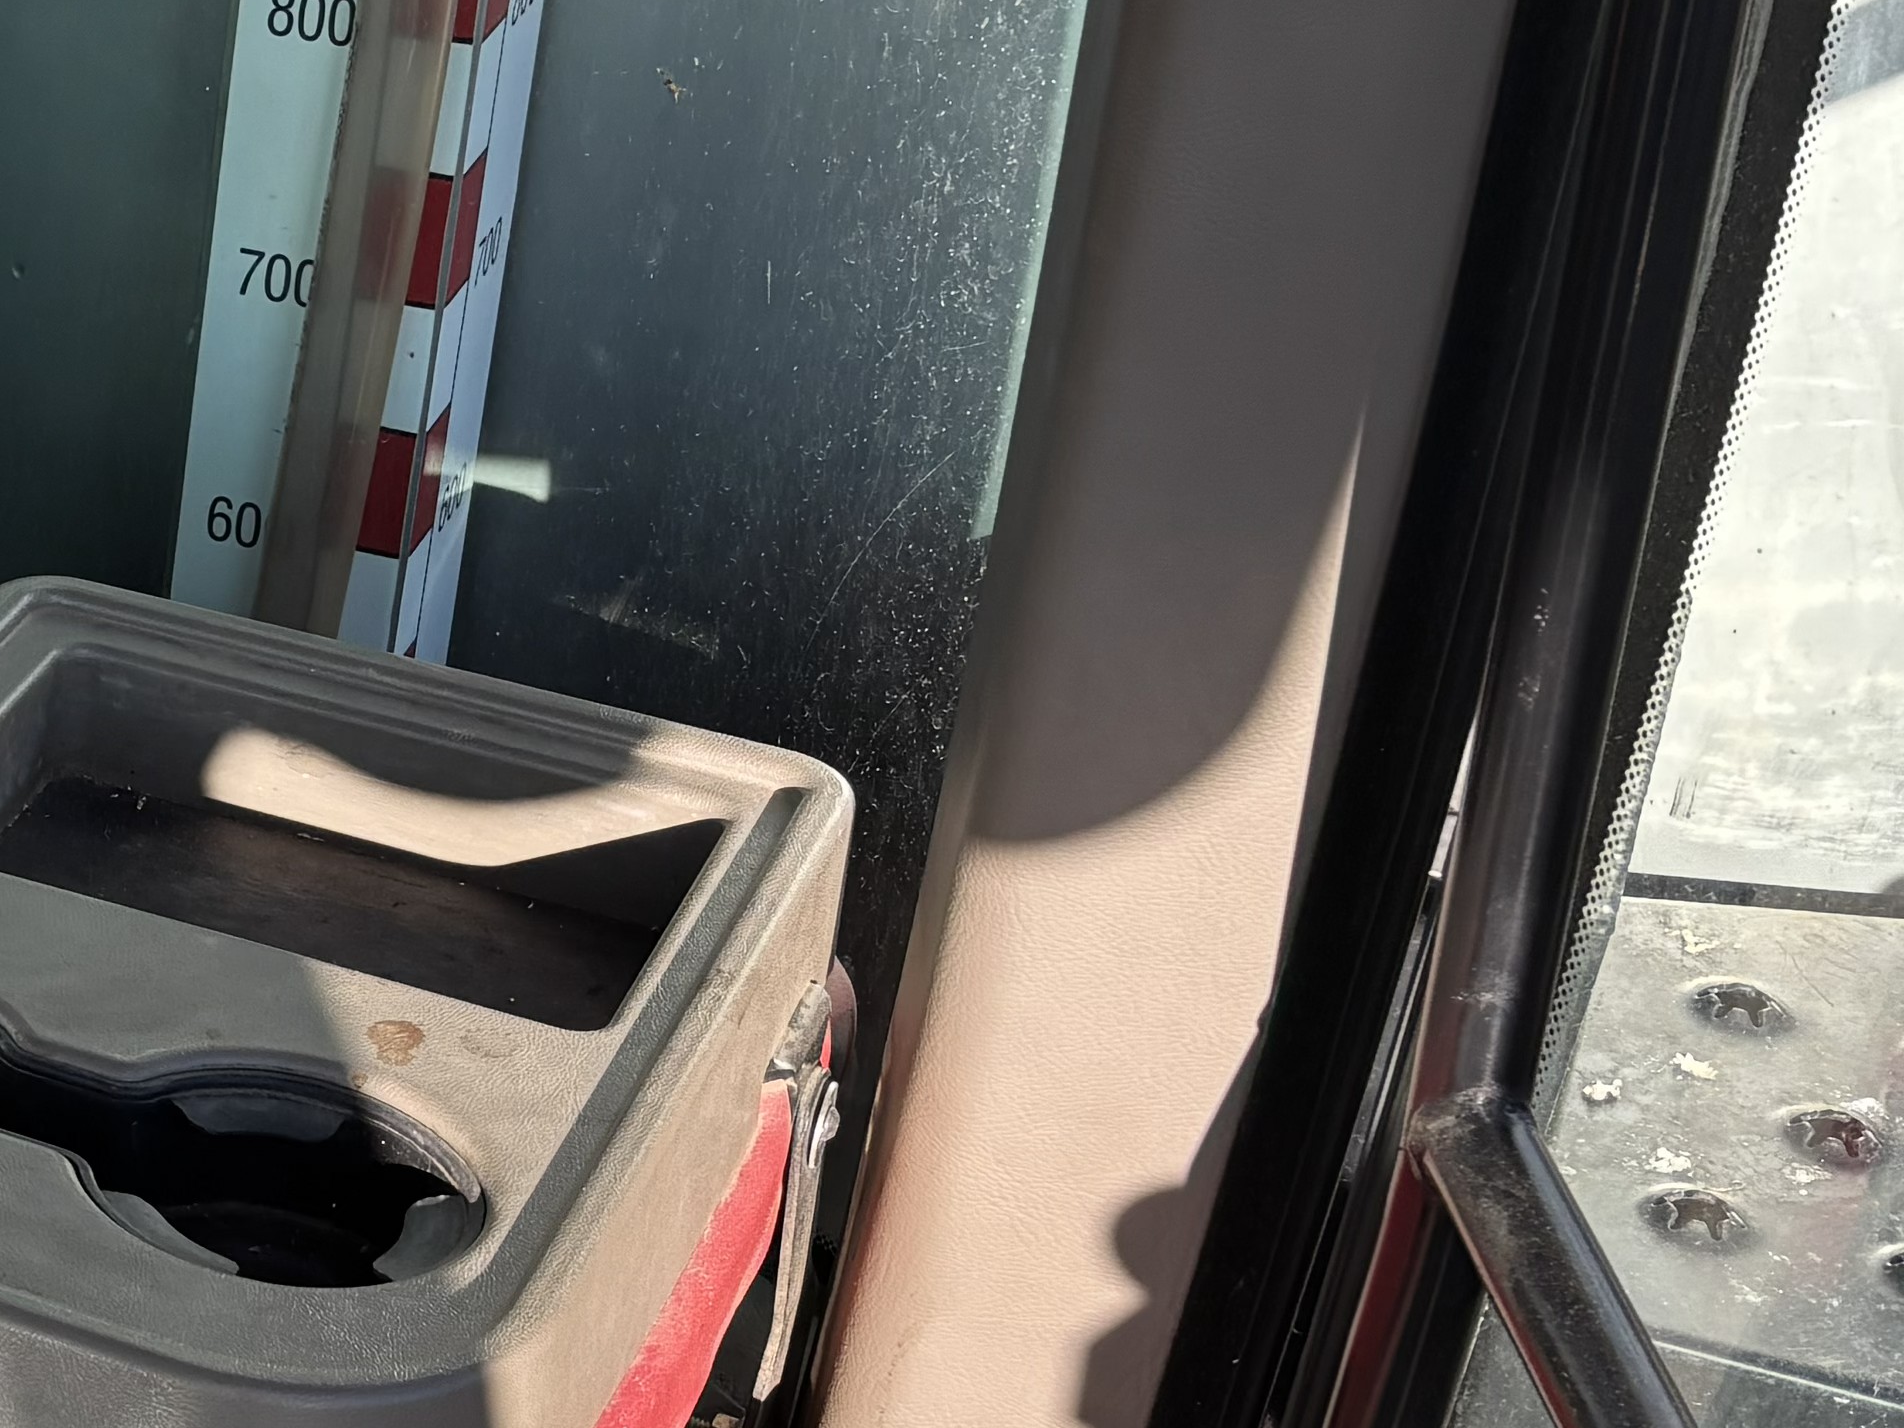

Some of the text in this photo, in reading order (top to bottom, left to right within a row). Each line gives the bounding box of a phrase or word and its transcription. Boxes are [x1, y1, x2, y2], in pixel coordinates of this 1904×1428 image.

[239, 247, 314, 307] 700
[473, 216, 502, 287] 700
[207, 496, 262, 548] 60
[438, 462, 467, 532] 600
